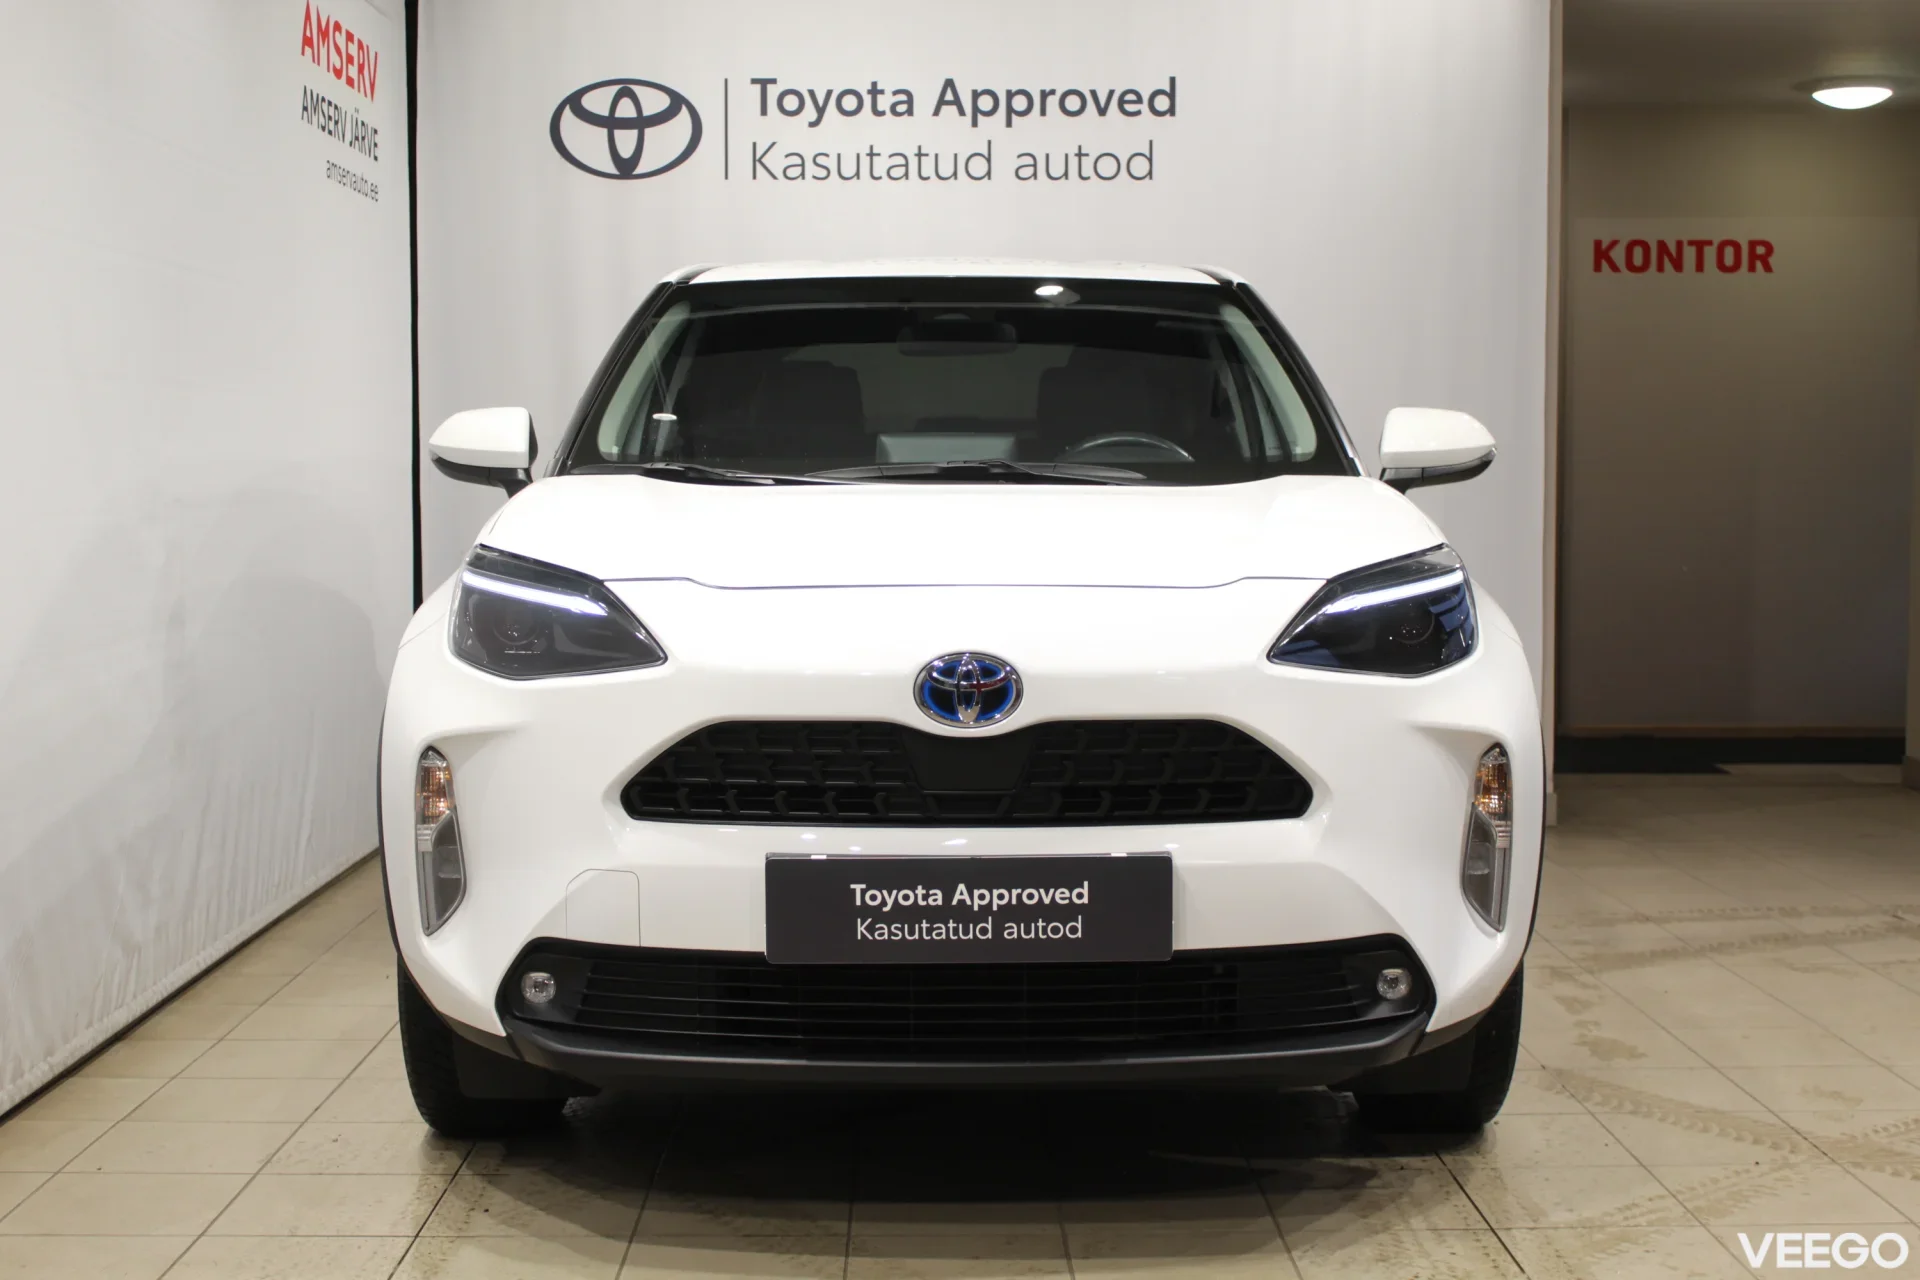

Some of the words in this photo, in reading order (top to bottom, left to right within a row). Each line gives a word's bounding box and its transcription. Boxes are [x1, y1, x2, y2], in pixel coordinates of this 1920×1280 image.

[301, 0, 379, 103] AMSERV
[750, 78, 915, 128] Toyota
[931, 76, 1178, 128] Approved
[301, 85, 348, 144] AMSERV
[348, 107, 379, 162] JÄRVE
[326, 160, 379, 202] amservauto.ee
[751, 140, 993, 181] Kasutatud
[1013, 140, 1155, 181] autod
[1593, 239, 1775, 274] KONTOR
[850, 883, 943, 912] Toyota
[951, 881, 1090, 911] Approved
[857, 916, 993, 941] Kasutatud
[1003, 915, 1083, 940] autod
